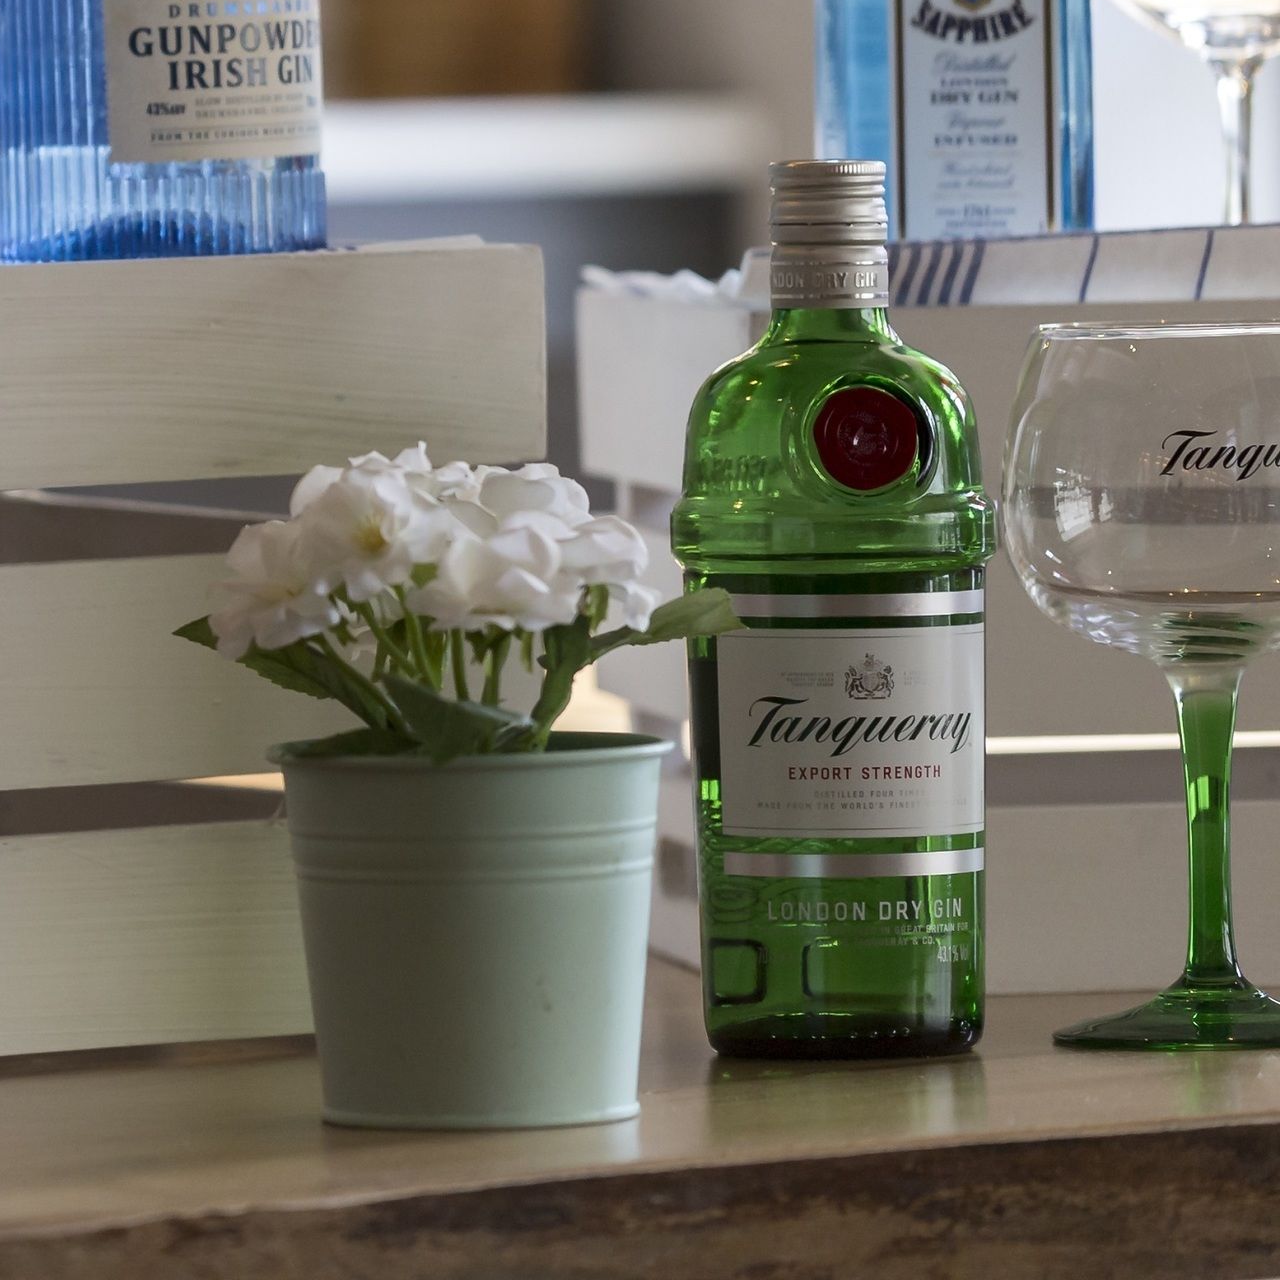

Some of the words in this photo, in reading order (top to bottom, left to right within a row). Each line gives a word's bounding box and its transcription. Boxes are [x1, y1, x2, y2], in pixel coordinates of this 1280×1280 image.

[128, 19, 318, 58] GUNPOWDE
[168, 56, 268, 91] IRISH
[277, 54, 313, 85] GIN
[816, 272, 849, 289] DRY
[854, 271, 878, 289] GIN
[747, 695, 973, 758] Tanqueray
[788, 766, 853, 781] EXPORT
[861, 765, 942, 781] STRENGTH
[870, 789, 894, 798] FOUR
[757, 801, 781, 810] MADE
[817, 801, 836, 810] THE
[841, 801, 885, 810] WORLD'S
[767, 900, 866, 922] LONDON
[879, 900, 923, 921] DRY
[934, 897, 962, 919] GIN
[926, 923, 956, 934] BRITAIN
[922, 936, 936, 945] CO.
